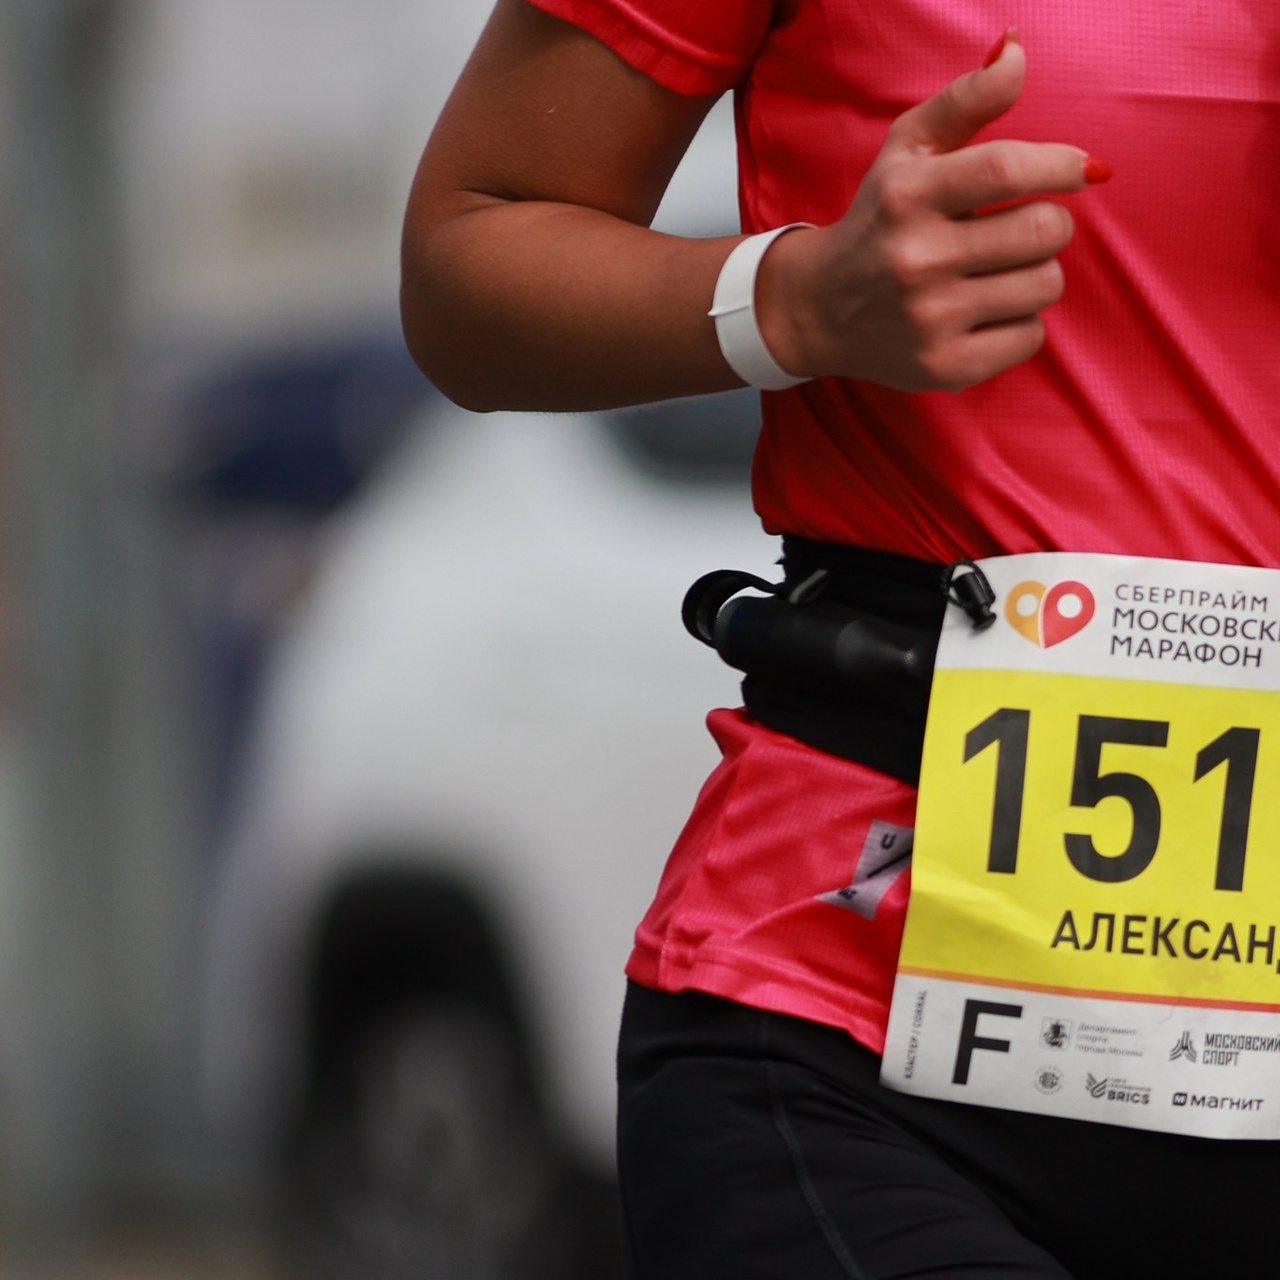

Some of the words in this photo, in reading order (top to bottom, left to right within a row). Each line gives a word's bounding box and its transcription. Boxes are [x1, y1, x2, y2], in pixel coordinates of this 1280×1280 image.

[1115, 584, 1268, 612] СБЕРПРАЙМ
[1110, 635, 1262, 668] МАРАФОН
[951, 999, 1023, 1086] F
[1202, 1050, 1240, 1067] СПОРТ
[1107, 1089, 1150, 1105] BRICS
